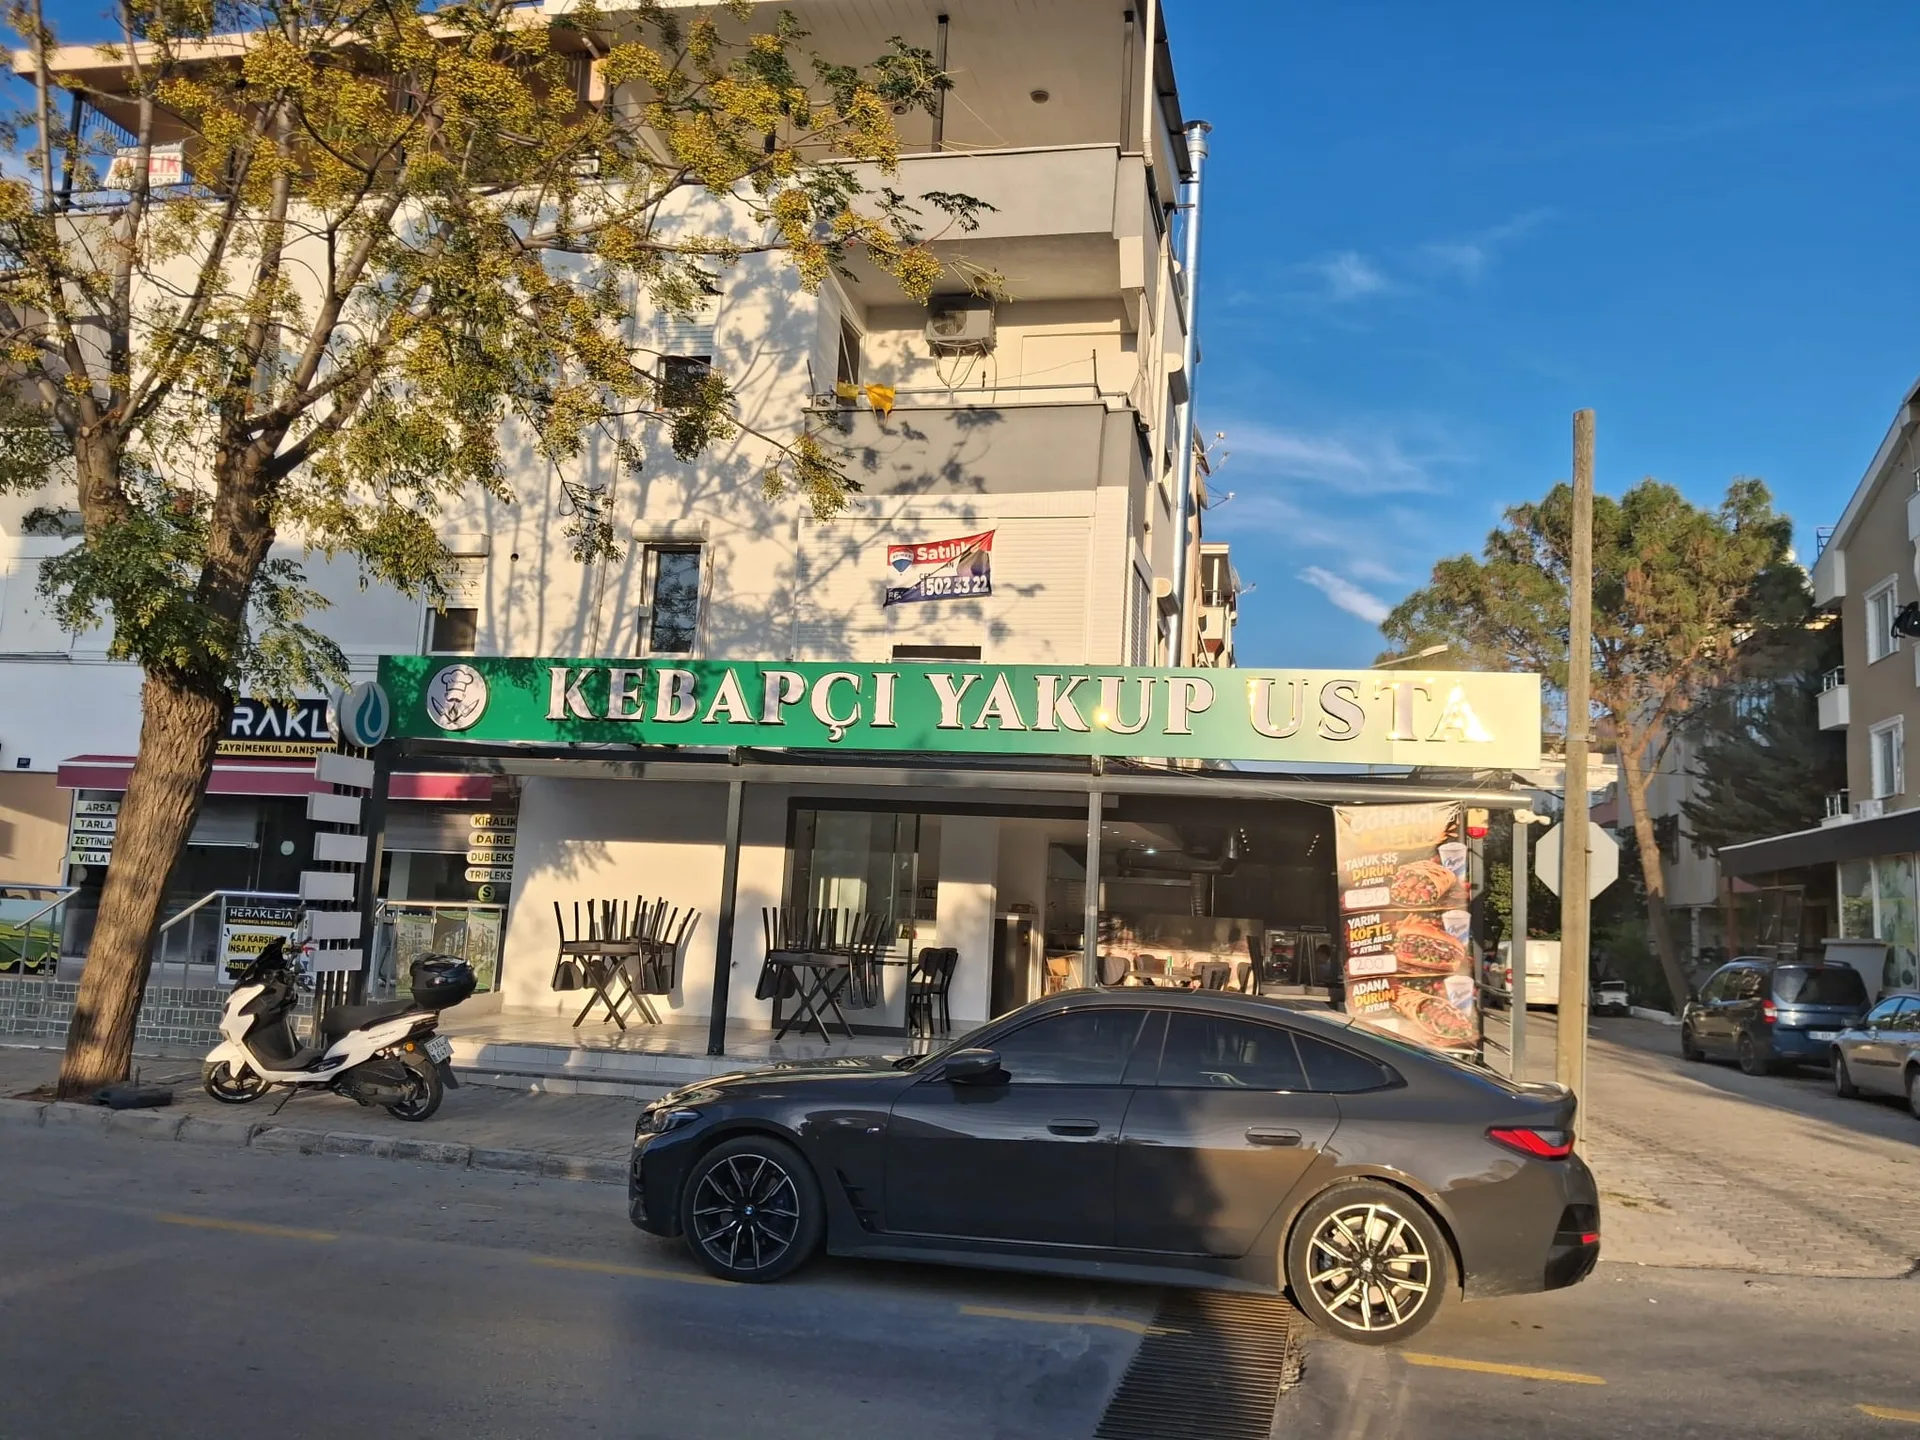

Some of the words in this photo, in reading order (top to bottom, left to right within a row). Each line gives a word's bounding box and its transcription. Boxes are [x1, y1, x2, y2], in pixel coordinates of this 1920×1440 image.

[926, 577, 952, 596] 502
[953, 576, 970, 594] 33
[972, 575, 989, 593] 22
[545, 667, 900, 742] KEBAPÇI
[924, 671, 1216, 735] YAKUP
[1247, 677, 1495, 744] USTA
[231, 706, 332, 739] RAKL
[285, 744, 338, 755] DANIŞMAN
[85, 803, 113, 812] ARSA
[80, 820, 113, 829] TARLA
[474, 816, 517, 827] KİRALIK
[476, 834, 511, 845] DAİRE
[78, 853, 107, 863] VİLLA
[471, 852, 514, 862] DUBLEKS
[1344, 854, 1380, 871] TAVUK
[469, 870, 512, 880] TRİPLEKS
[1347, 913, 1380, 930] YARIM
[231, 934, 246, 942] KAT
[1353, 978, 1391, 997] ADANA
